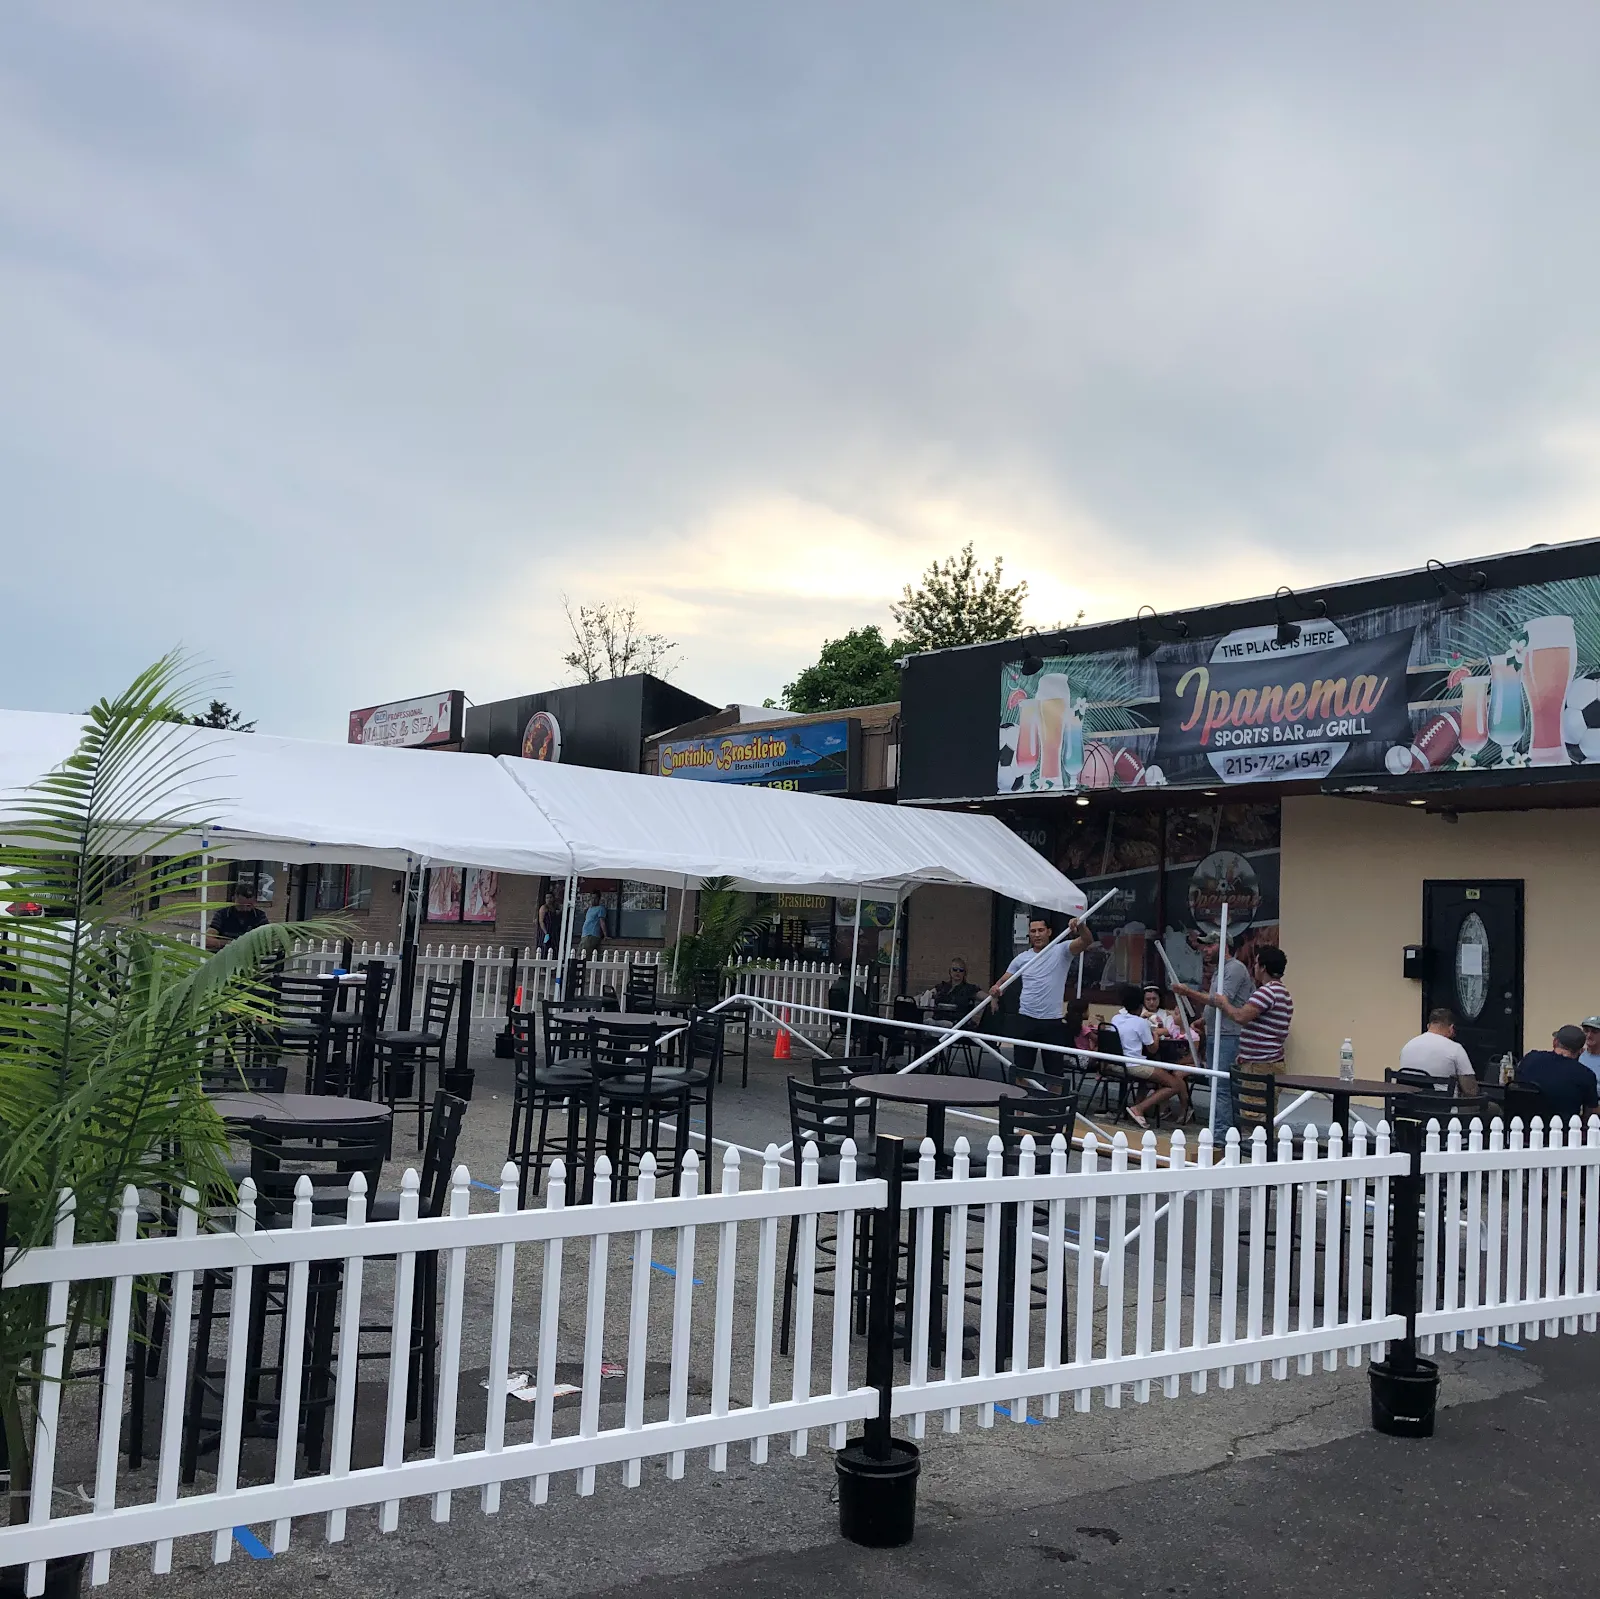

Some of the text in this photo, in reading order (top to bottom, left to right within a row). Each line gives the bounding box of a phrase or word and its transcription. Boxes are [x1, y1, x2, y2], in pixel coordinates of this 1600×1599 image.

[1221, 643, 1244, 658] THE
[1290, 638, 1300, 649] IS
[1303, 630, 1335, 647] HERE
[388, 707, 424, 721] PROFESSIONAL
[1175, 666, 1389, 745] Ipanema
[363, 715, 434, 743] NAILS & SPA
[1214, 717, 1371, 747] SPORTS BAR and GRILL
[660, 735, 787, 777] Cantinho Brasileiro
[734, 758, 800, 771] Brasilian Cuisine
[778, 892, 827, 908] Brasileiro
